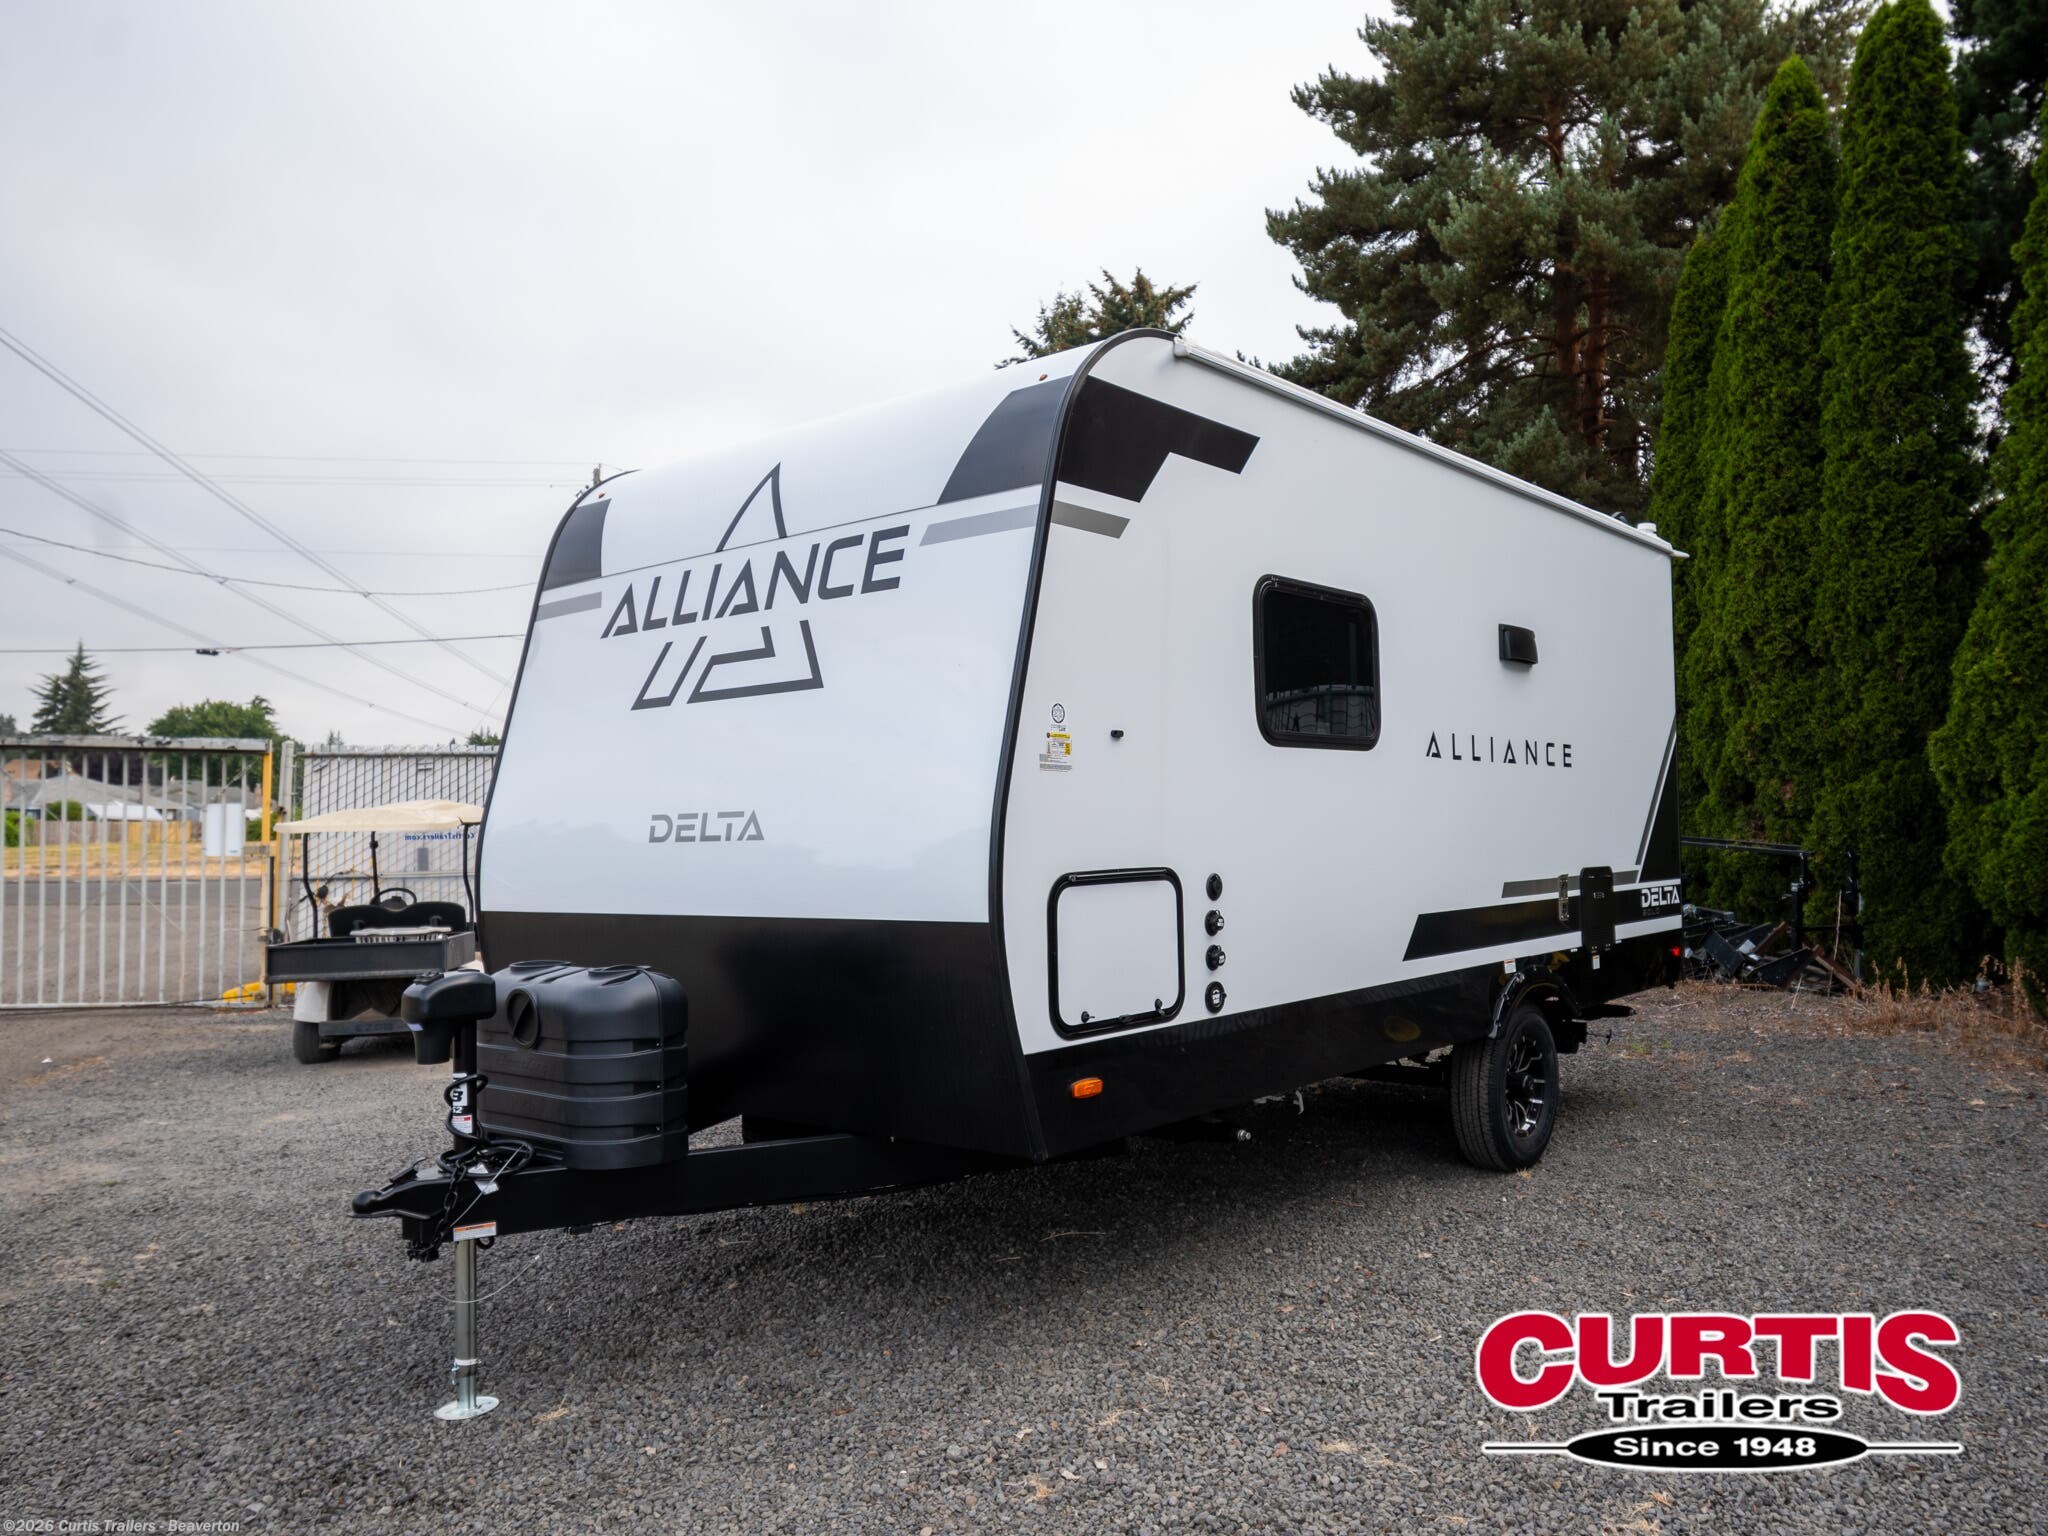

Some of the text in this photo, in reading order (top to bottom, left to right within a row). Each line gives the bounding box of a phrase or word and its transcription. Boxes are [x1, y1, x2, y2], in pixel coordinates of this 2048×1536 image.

[600, 524, 910, 639] ALLIANCE
[1425, 730, 1572, 768] ALLIANCE
[648, 809, 765, 843] DELTA
[1641, 885, 1681, 908] DELTA
